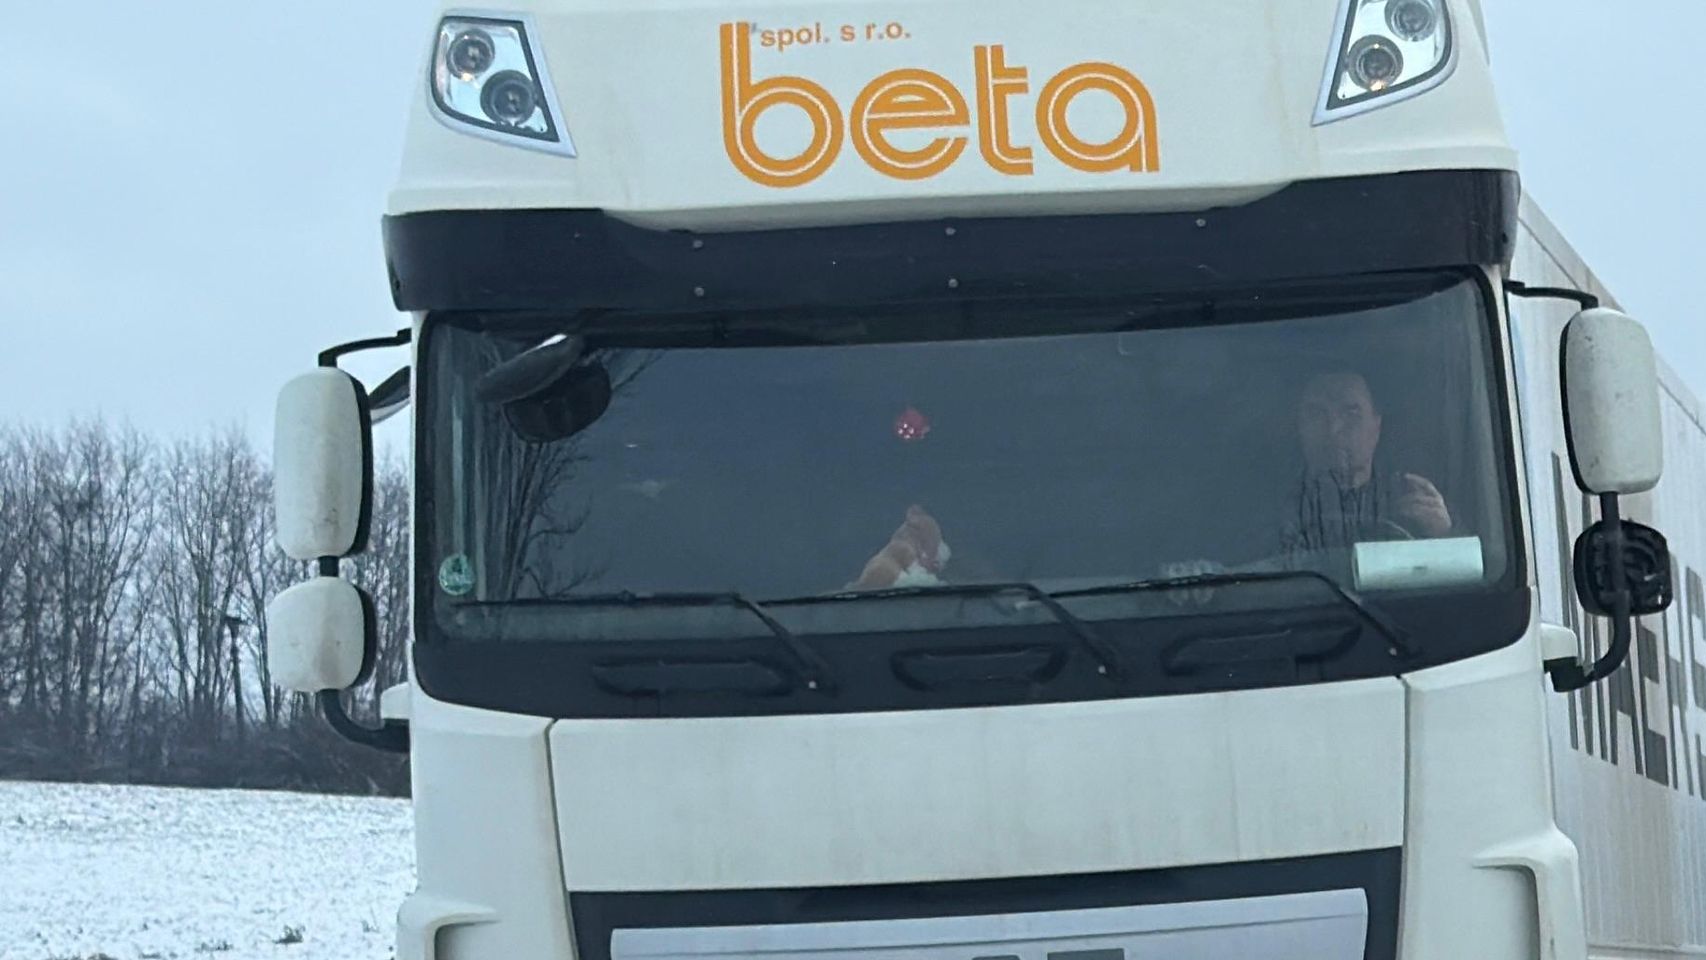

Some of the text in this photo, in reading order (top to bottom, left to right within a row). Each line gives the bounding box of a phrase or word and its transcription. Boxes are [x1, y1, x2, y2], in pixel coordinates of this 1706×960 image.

[760, 21, 911, 53] spol. s r.o.
[719, 21, 1160, 188] beta
